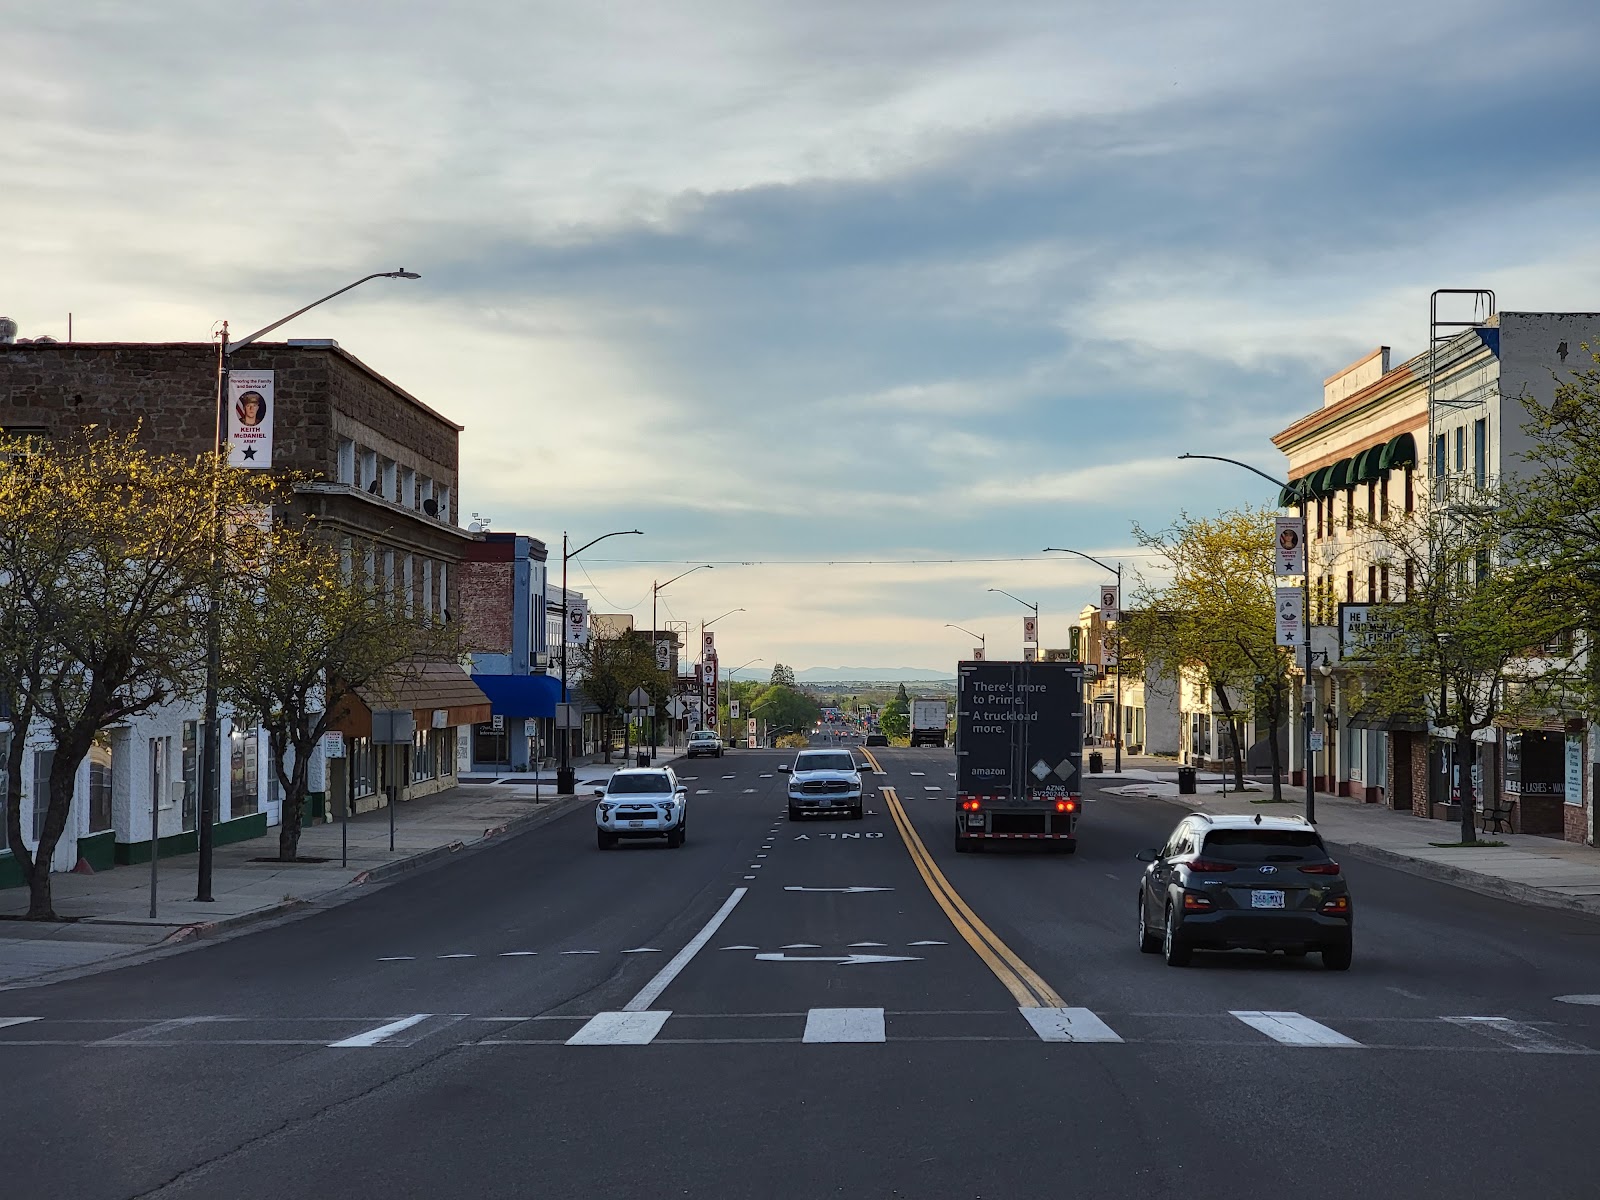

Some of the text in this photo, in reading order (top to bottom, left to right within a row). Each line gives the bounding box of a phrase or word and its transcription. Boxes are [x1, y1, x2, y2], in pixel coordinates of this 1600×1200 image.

[973, 682, 1046, 692] There's more
[973, 695, 1024, 704] to Prime.
[972, 711, 1038, 720] A truckload
[1526, 783, 1546, 793] LASHES
